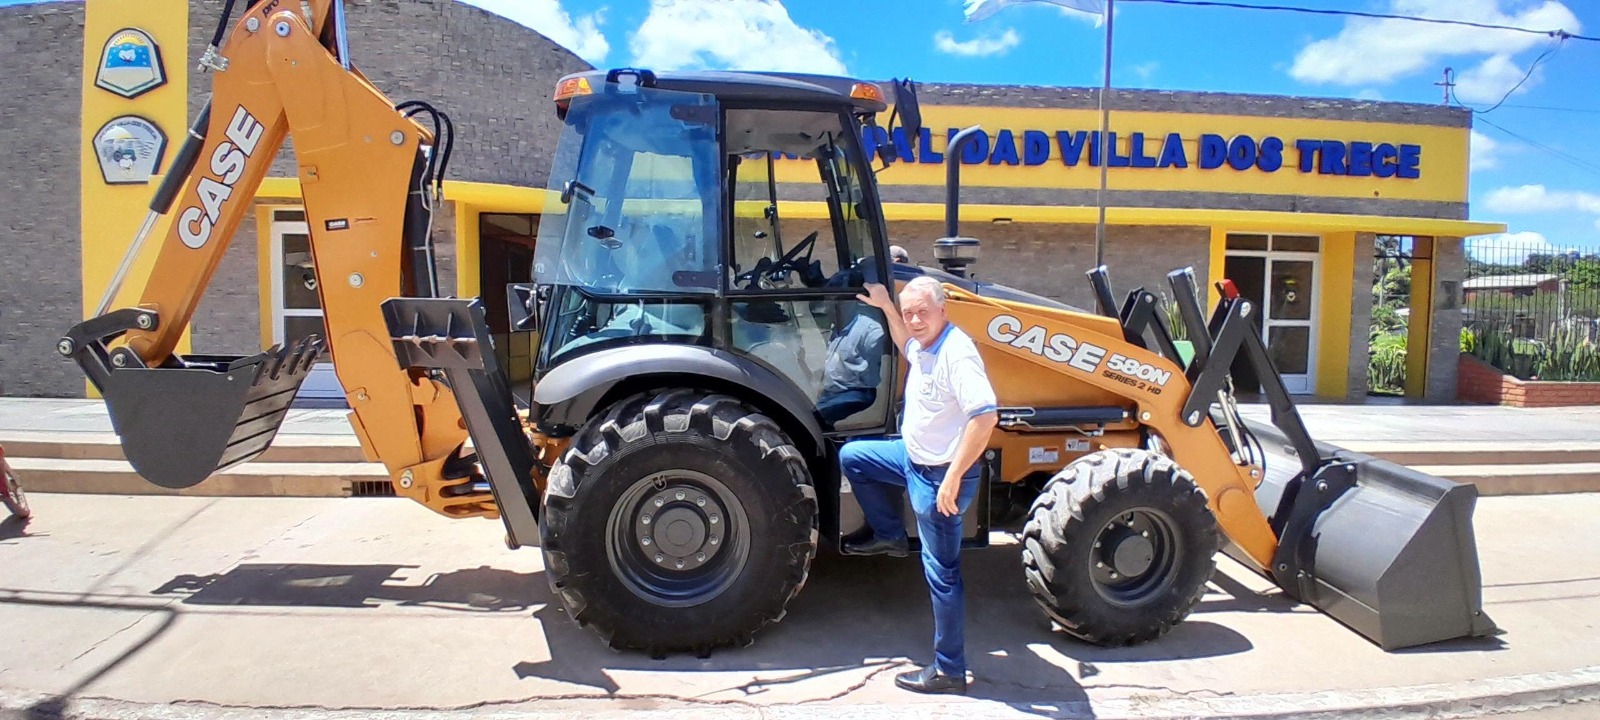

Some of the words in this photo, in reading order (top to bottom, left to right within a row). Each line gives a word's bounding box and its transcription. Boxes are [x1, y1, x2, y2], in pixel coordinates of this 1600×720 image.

[178, 104, 265, 249] CASE
[1056, 130, 1188, 168] VILLA
[1198, 133, 1284, 172] DOS
[1296, 139, 1421, 179] TRECE
[987, 314, 1107, 373] CASE
[1106, 353, 1172, 386] 580N
[1102, 370, 1137, 387] SERIES
[1138, 382, 1146, 390] 2
[1147, 385, 1162, 395] HD
